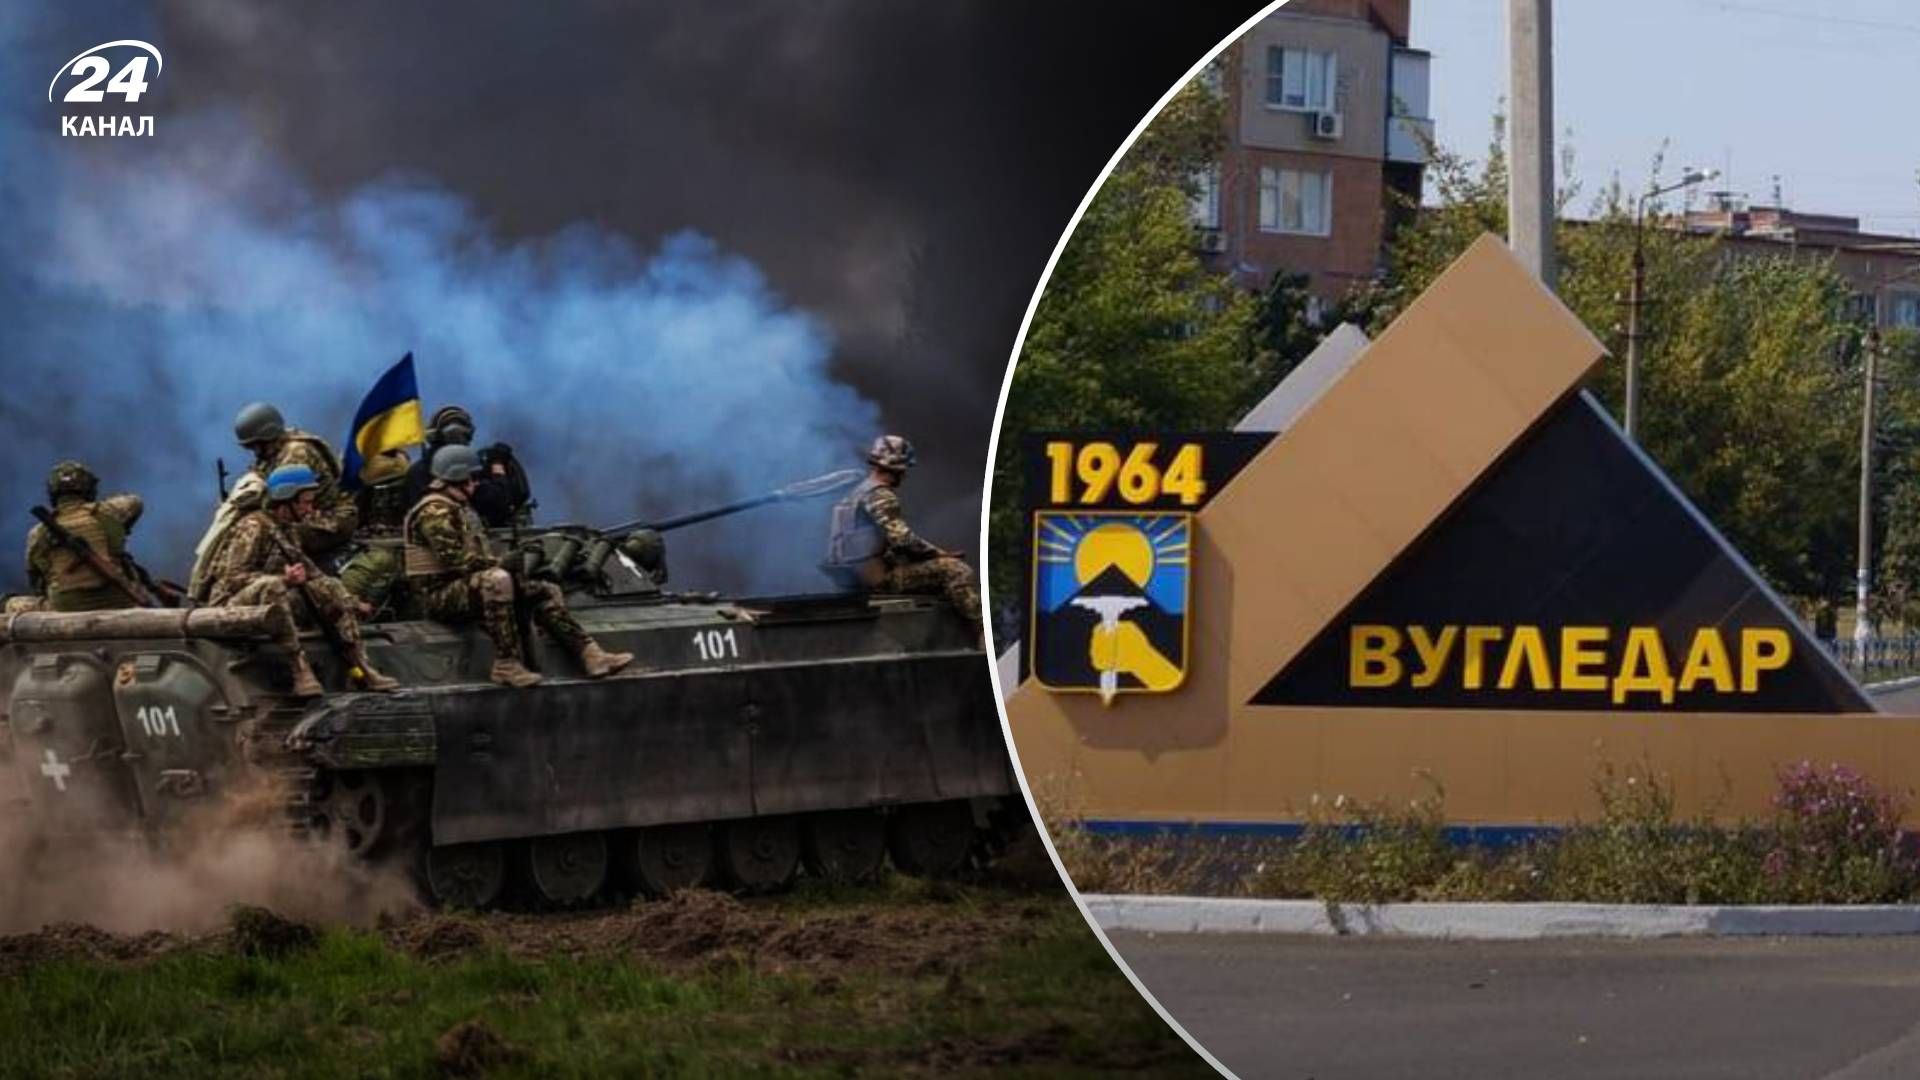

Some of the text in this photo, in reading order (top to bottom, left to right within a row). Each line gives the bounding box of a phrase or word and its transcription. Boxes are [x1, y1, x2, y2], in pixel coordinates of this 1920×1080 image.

[1046, 441, 1206, 505] 1964
[693, 627, 739, 660] 101
[1349, 624, 1792, 704] ВУГЛЕДАР
[137, 705, 182, 737] 101
